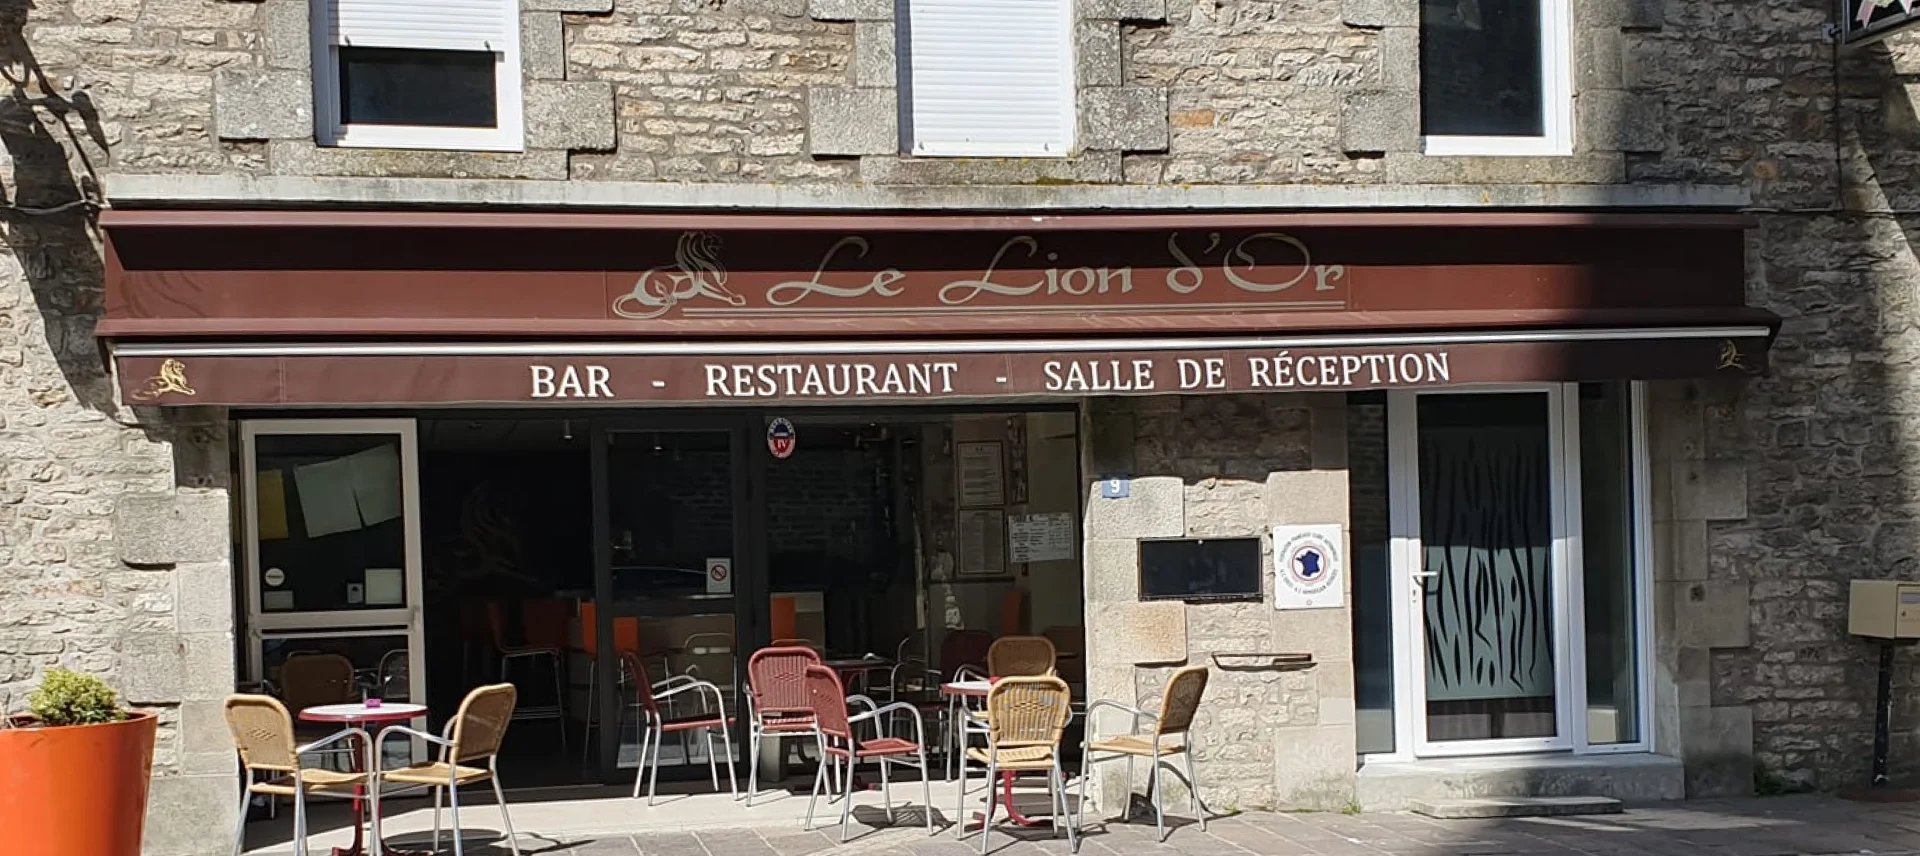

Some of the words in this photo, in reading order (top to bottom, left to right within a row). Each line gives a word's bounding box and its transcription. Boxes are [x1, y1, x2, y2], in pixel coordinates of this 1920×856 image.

[766, 235, 905, 306] Le
[939, 234, 1132, 304] Lion
[1167, 232, 1345, 294] d'Or
[530, 364, 614, 397] BAR
[704, 361, 958, 396] RESTAURANT
[1044, 359, 1155, 393] SALLE
[1177, 358, 1226, 390] DE
[1248, 350, 1450, 386] RÉCEPTION
[1110, 478, 1120, 494] 9
